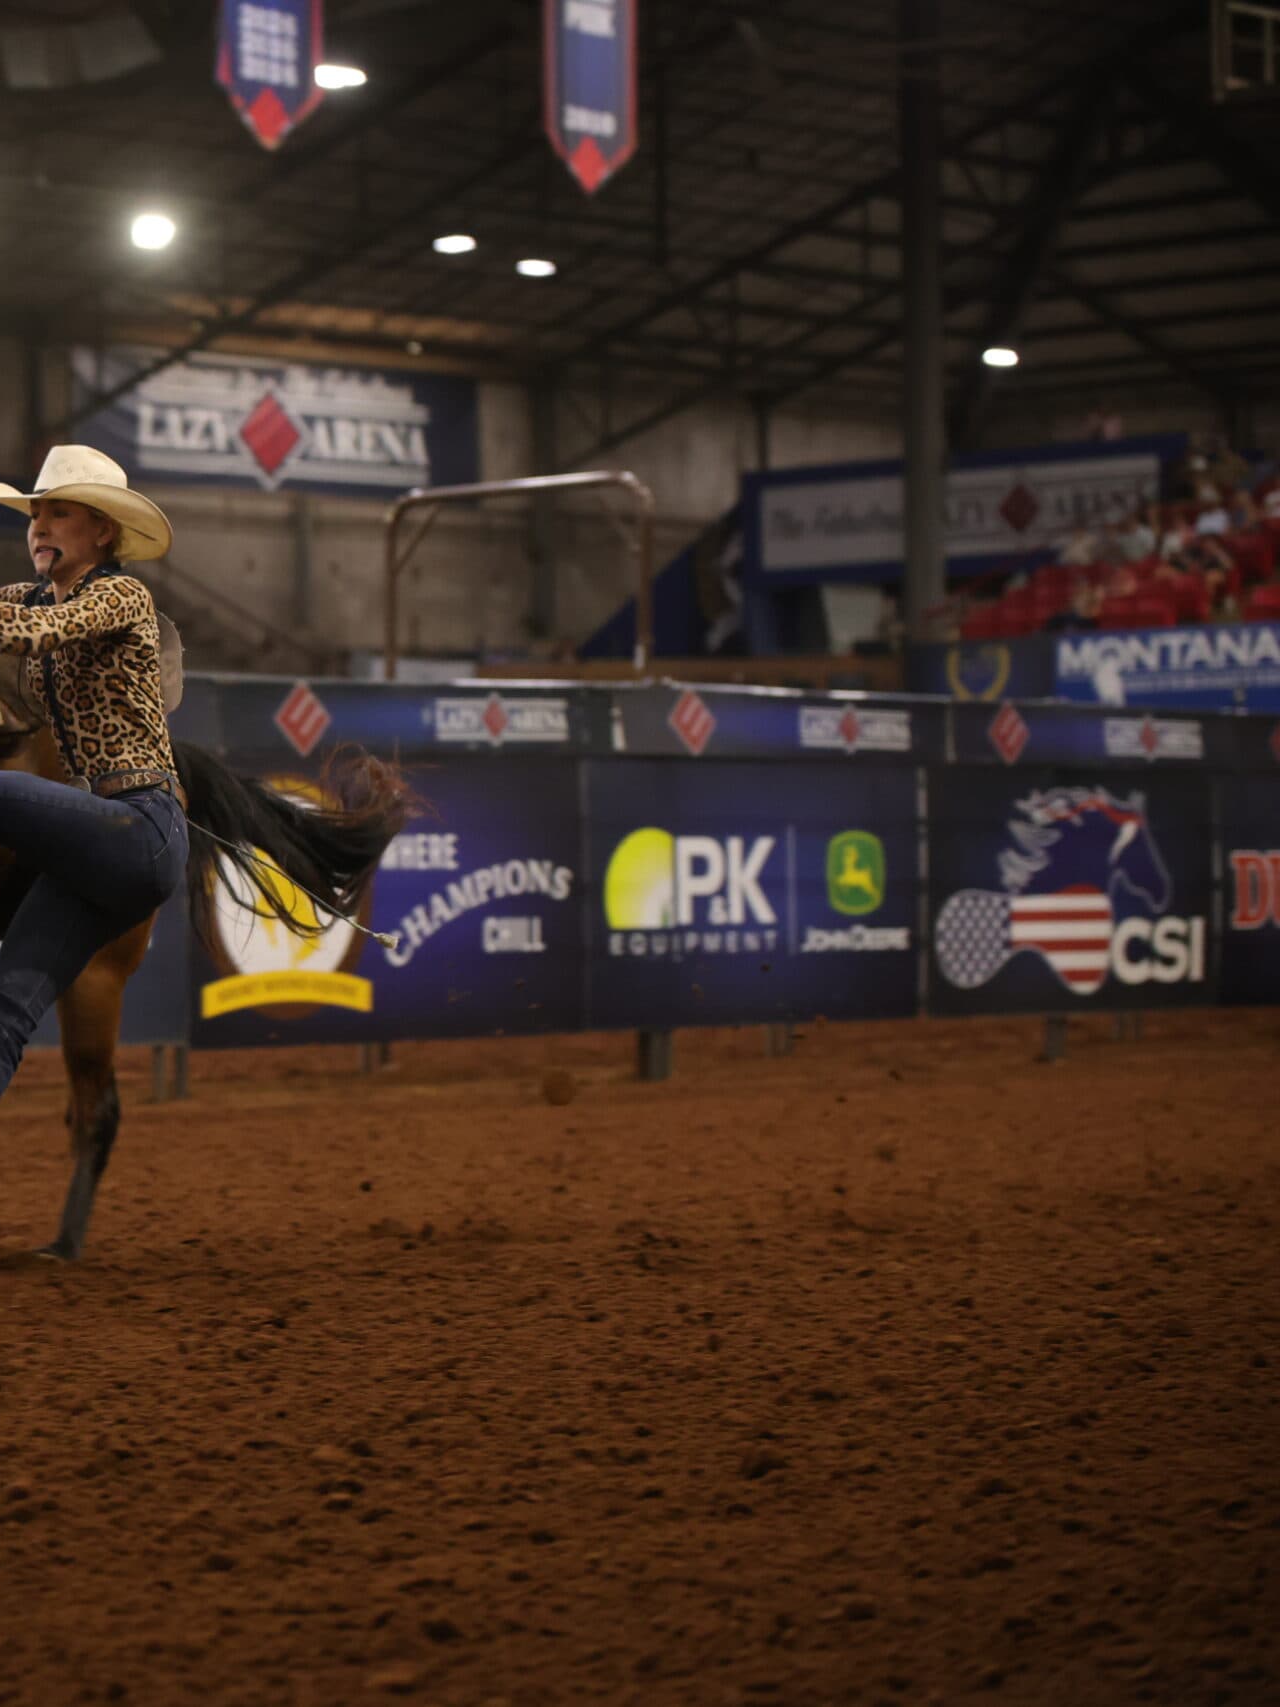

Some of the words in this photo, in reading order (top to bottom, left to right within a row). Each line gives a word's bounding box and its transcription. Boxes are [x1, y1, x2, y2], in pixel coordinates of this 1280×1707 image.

[1058, 626, 1280, 678] MONTANA
[121, 771, 151, 789] DES
[676, 835, 778, 926] P&K
[384, 858, 574, 967] CHAMPIONS
[482, 915, 546, 954] CHILL
[608, 929, 778, 957] EQUIPMENT
[1111, 915, 1206, 985] CSI
